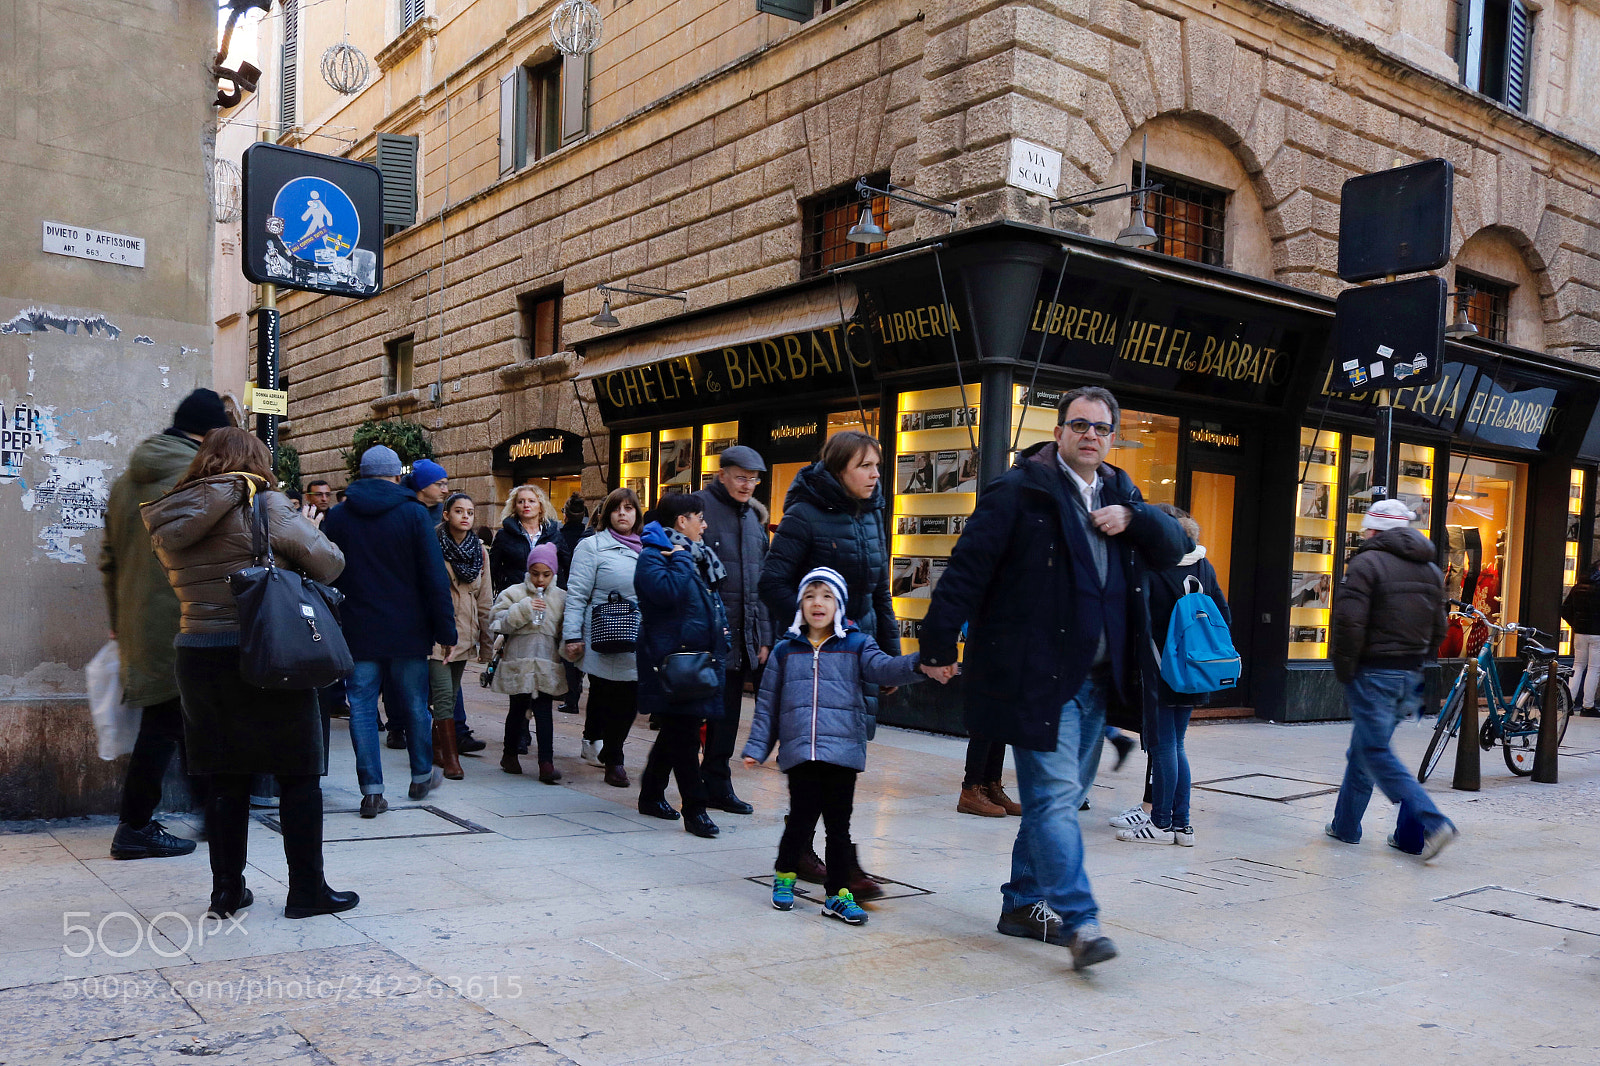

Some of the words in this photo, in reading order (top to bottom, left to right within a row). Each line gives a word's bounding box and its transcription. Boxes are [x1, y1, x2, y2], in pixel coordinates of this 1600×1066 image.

[1028, 151, 1046, 168] VIA
[1018, 166, 1052, 188] SCALA
[46, 225, 78, 240] DIVIETO
[96, 234, 141, 250] AFFISSIONE
[63, 244, 77, 253] ART.
[86, 248, 102, 257] 663.
[878, 302, 961, 345] LIBRERIA
[1031, 299, 1118, 346] LIBRERIA
[1196, 335, 1290, 387] BARBATO
[605, 356, 698, 409] GHELFI
[705, 370, 722, 393] &
[771, 422, 818, 440] goldenpoint
[1190, 429, 1240, 447] goldenpoint
[509, 435, 564, 462] goldenpoint
